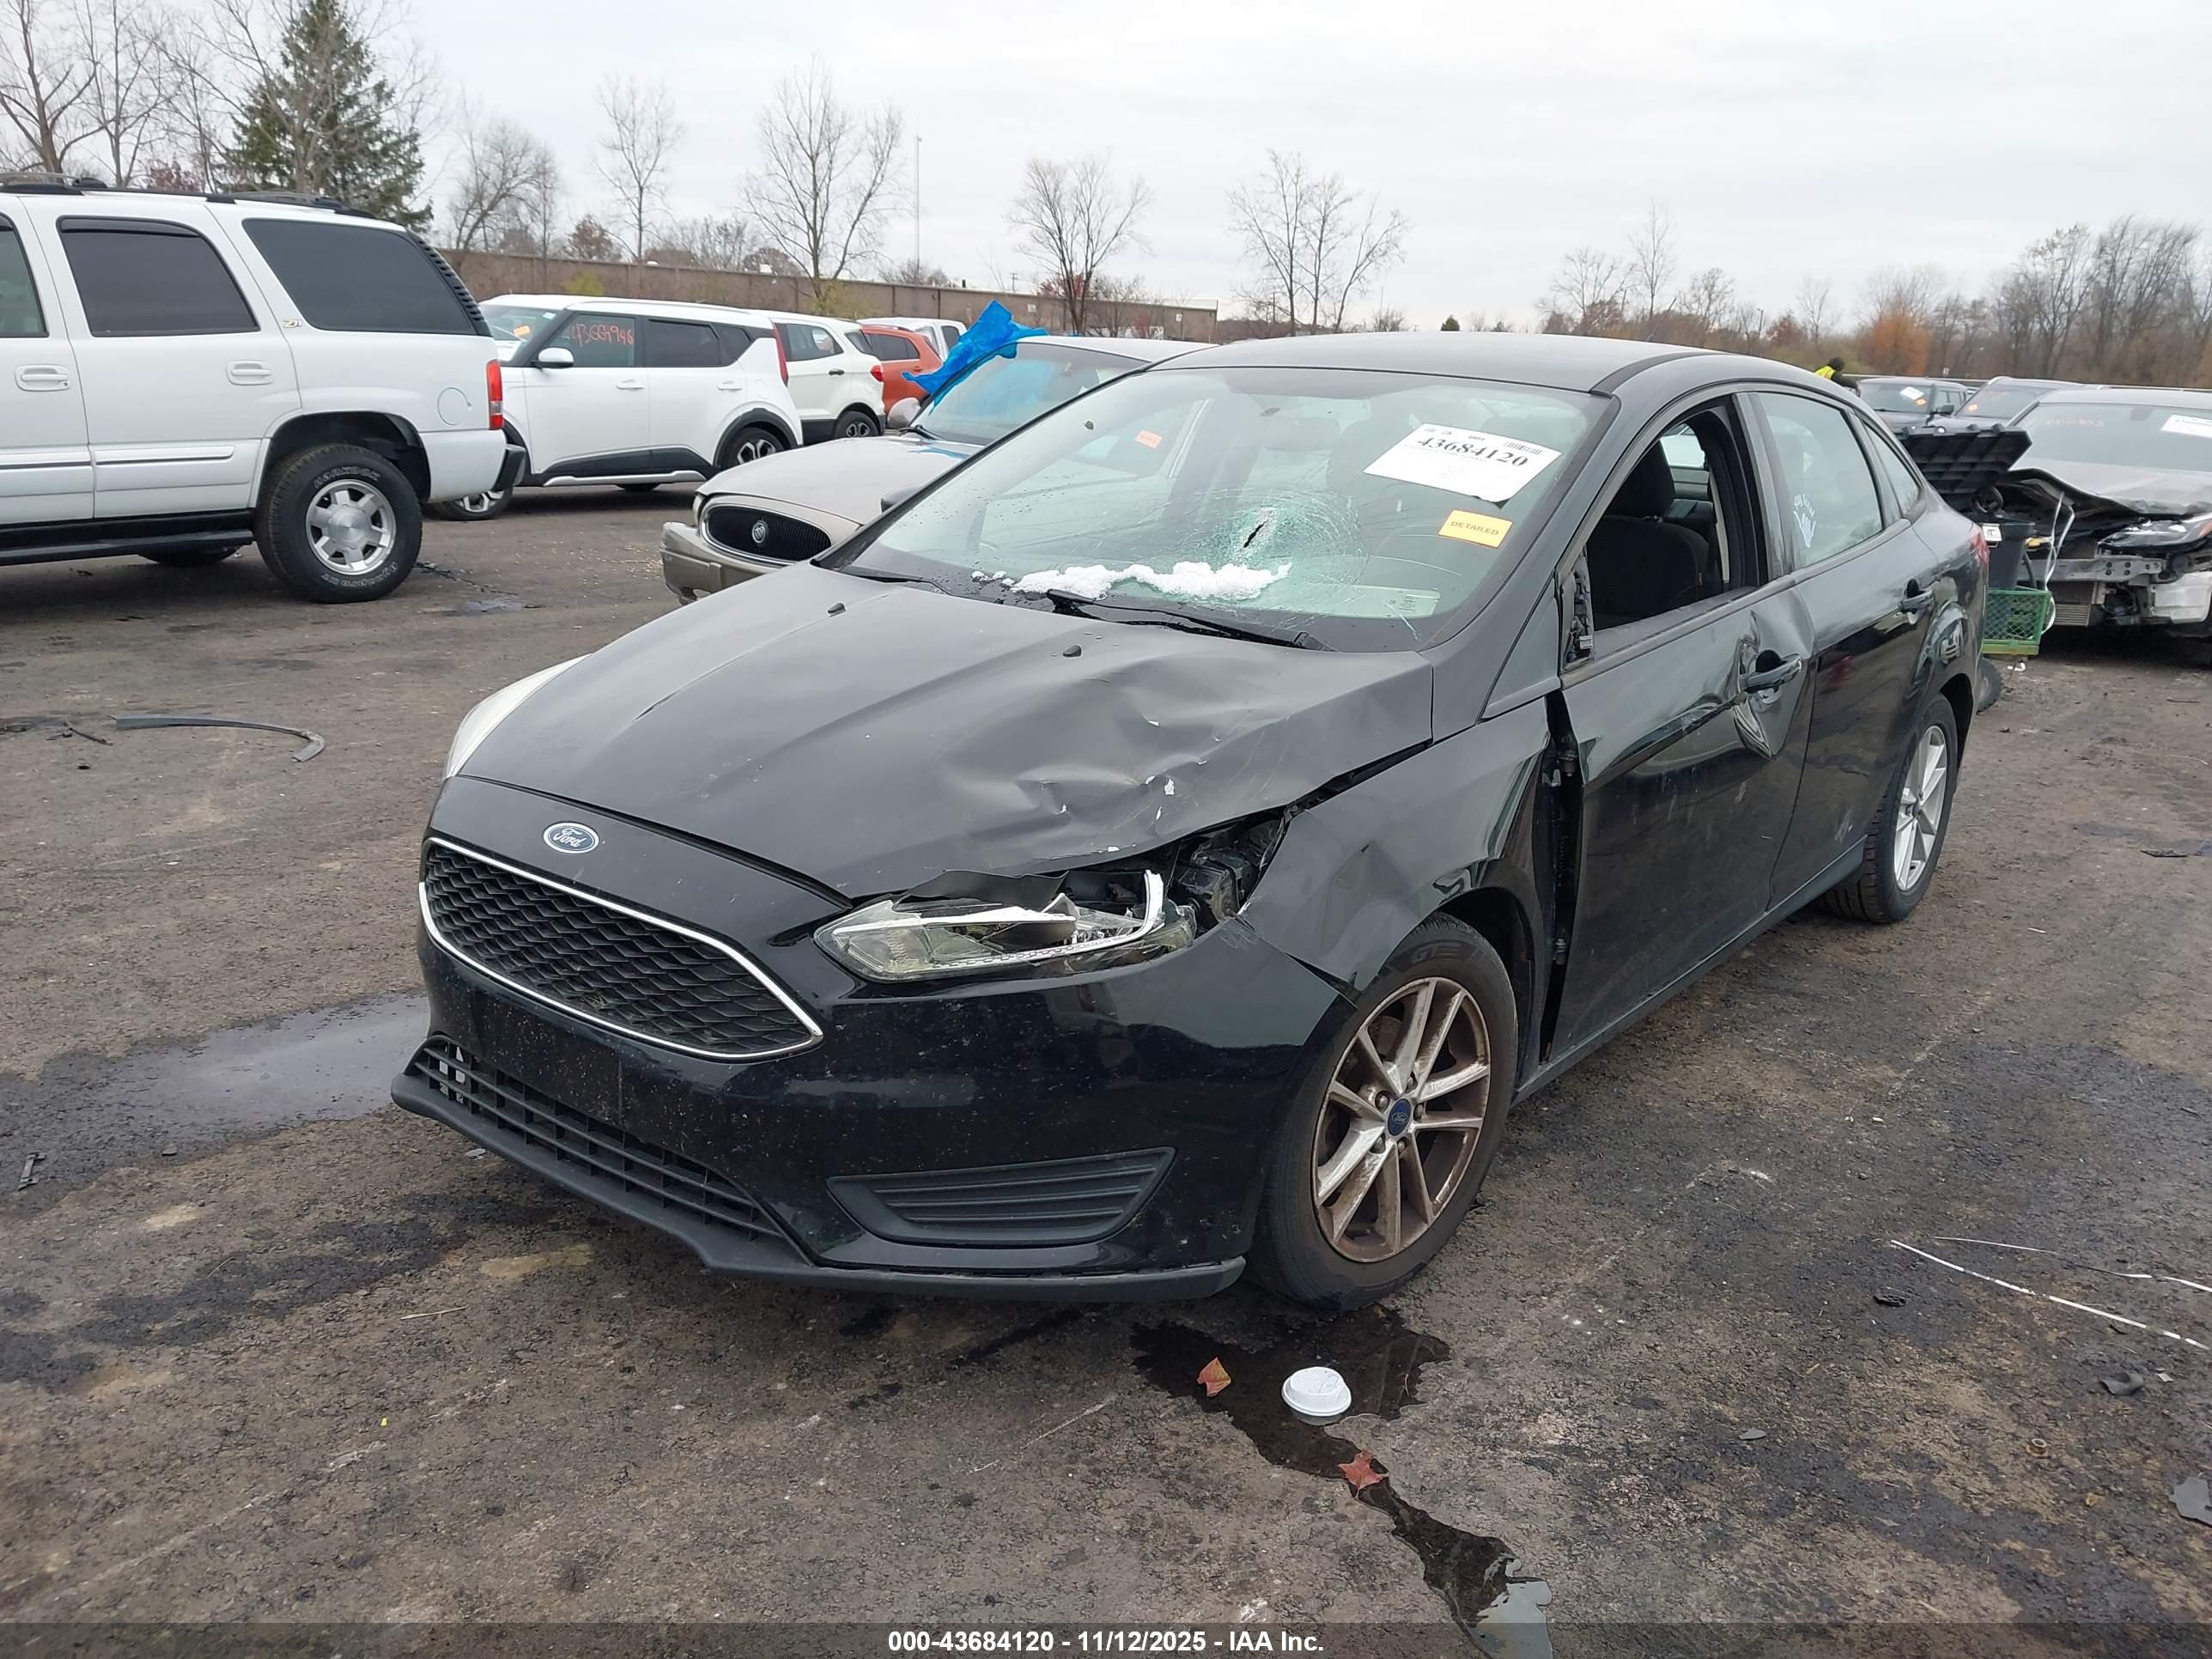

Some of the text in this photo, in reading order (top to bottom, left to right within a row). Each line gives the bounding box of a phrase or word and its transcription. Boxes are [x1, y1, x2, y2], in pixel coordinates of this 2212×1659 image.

[1418, 437, 1528, 466] 43684120
[1450, 521, 1499, 536] DETAILED
[552, 828, 587, 848] Ford
